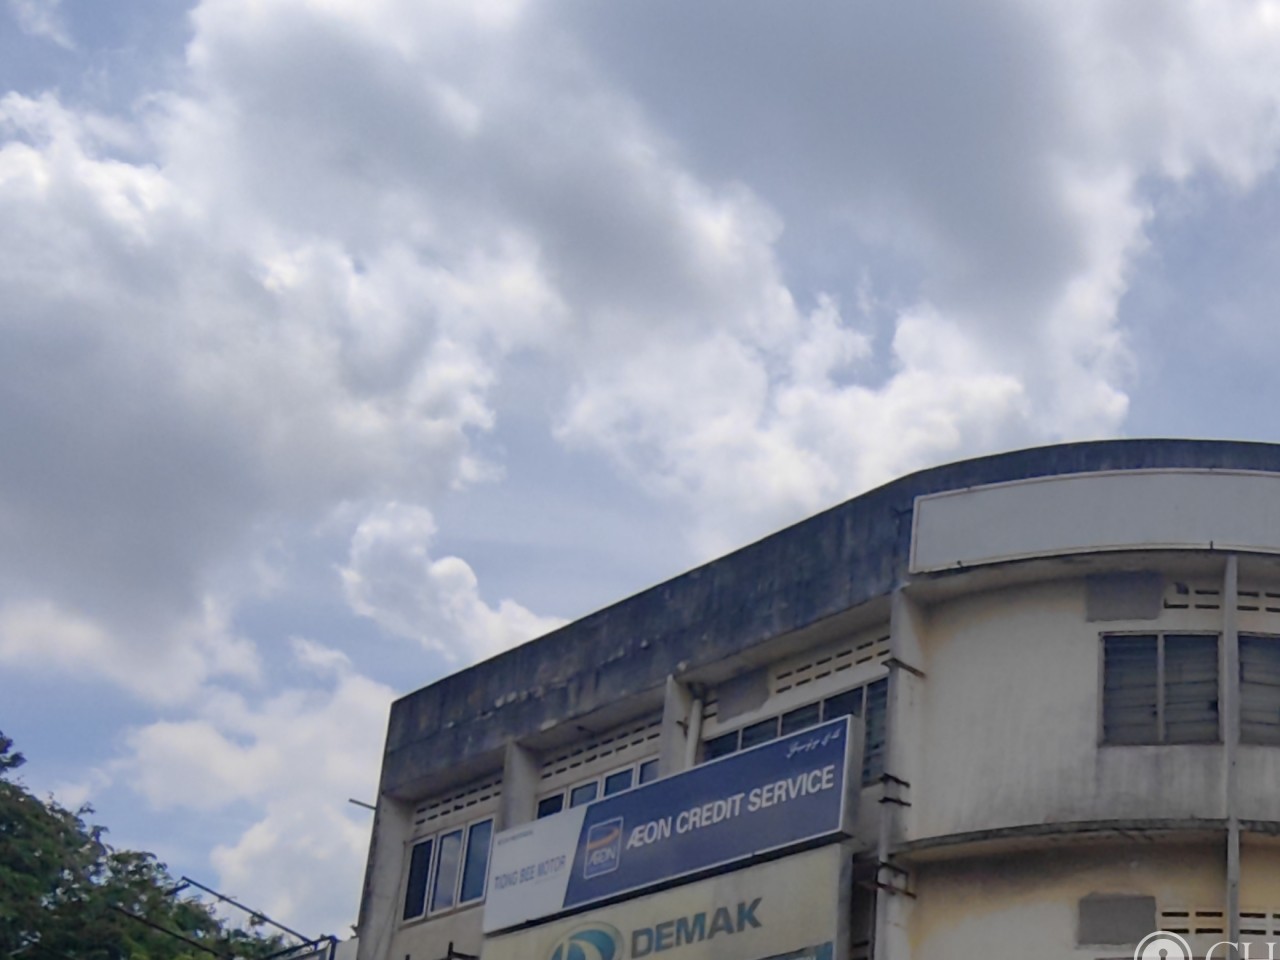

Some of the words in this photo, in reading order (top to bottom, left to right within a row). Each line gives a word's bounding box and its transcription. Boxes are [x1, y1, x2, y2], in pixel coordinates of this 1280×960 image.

[675, 793, 745, 833] CREDIT
[747, 764, 836, 813] SERVICE
[630, 897, 762, 960] DEMAK
